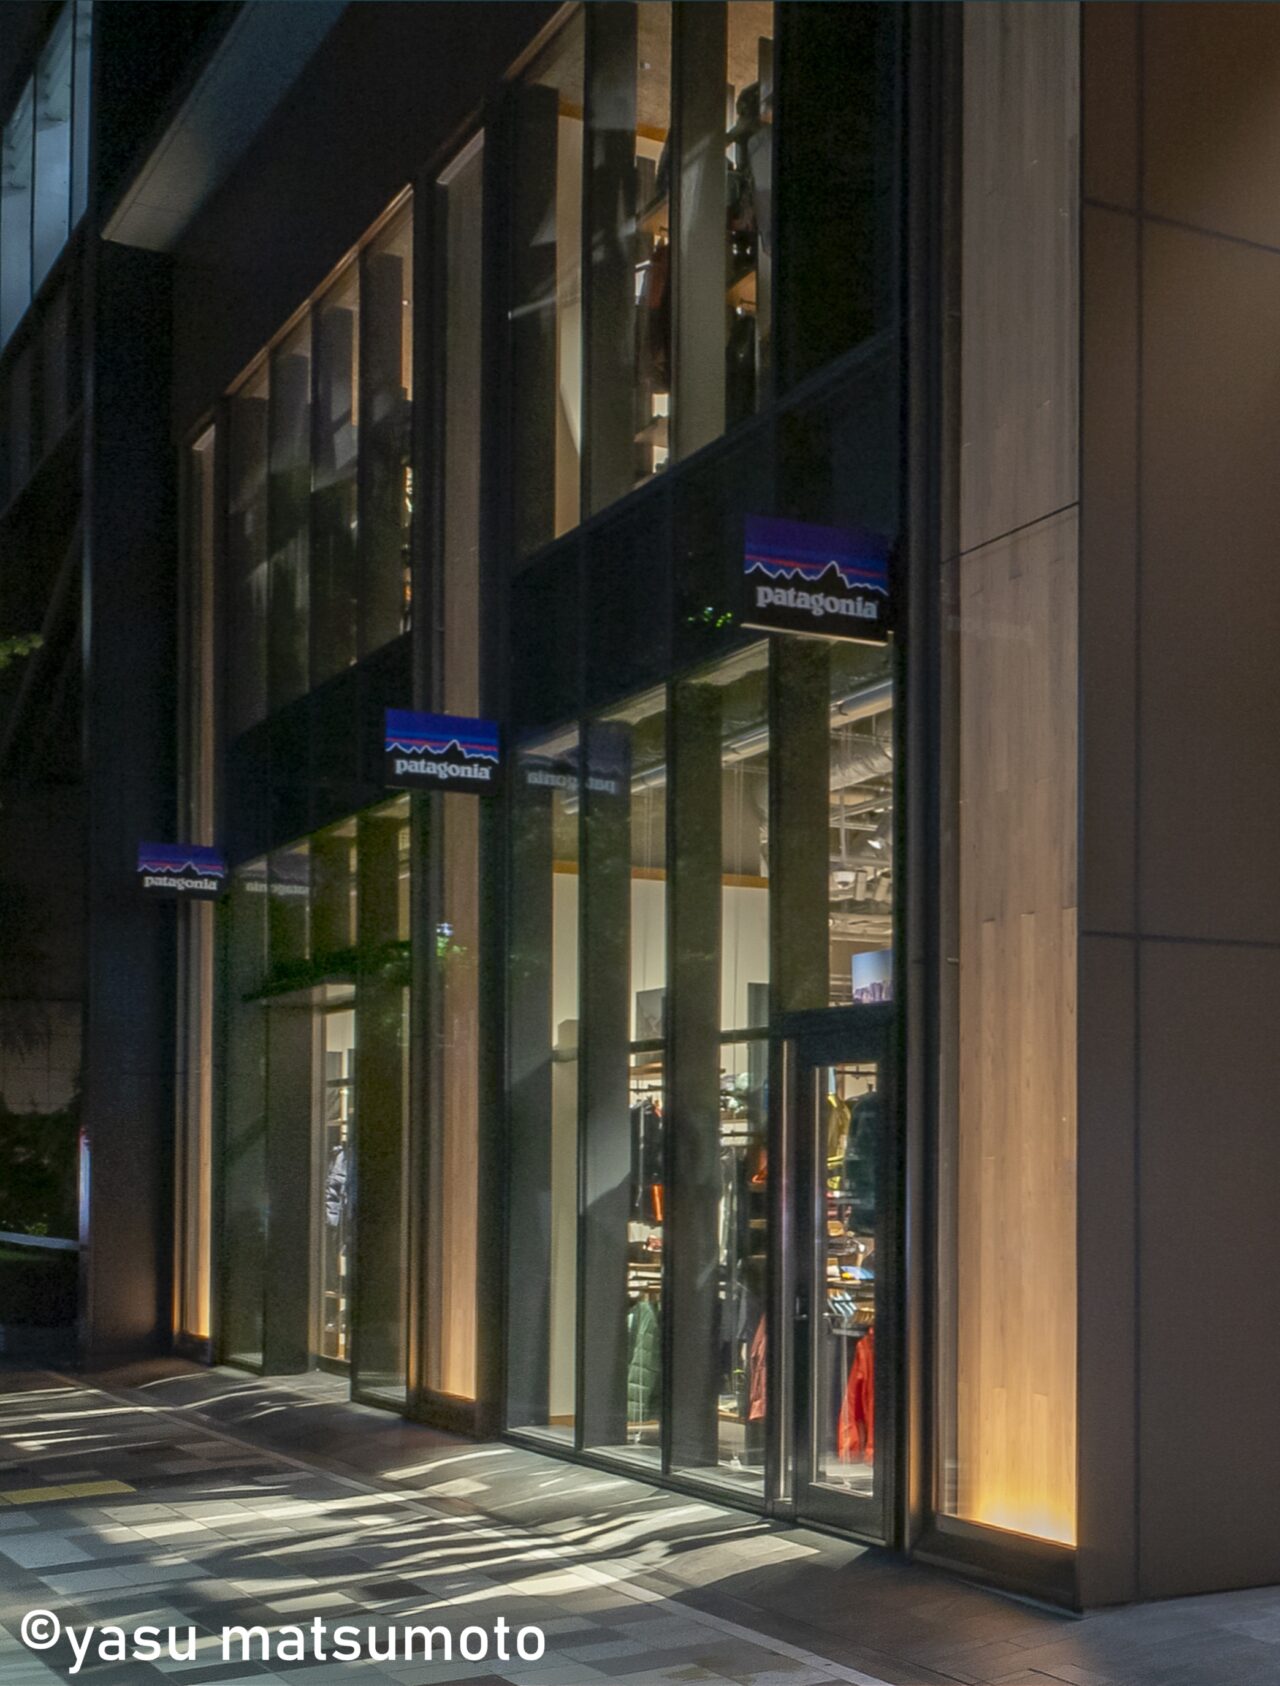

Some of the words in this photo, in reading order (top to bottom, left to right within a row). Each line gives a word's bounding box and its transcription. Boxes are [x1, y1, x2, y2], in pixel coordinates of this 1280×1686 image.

[756, 586, 878, 619] patagonia
[395, 759, 491, 780] patagonia
[143, 876, 217, 890] patagonia
